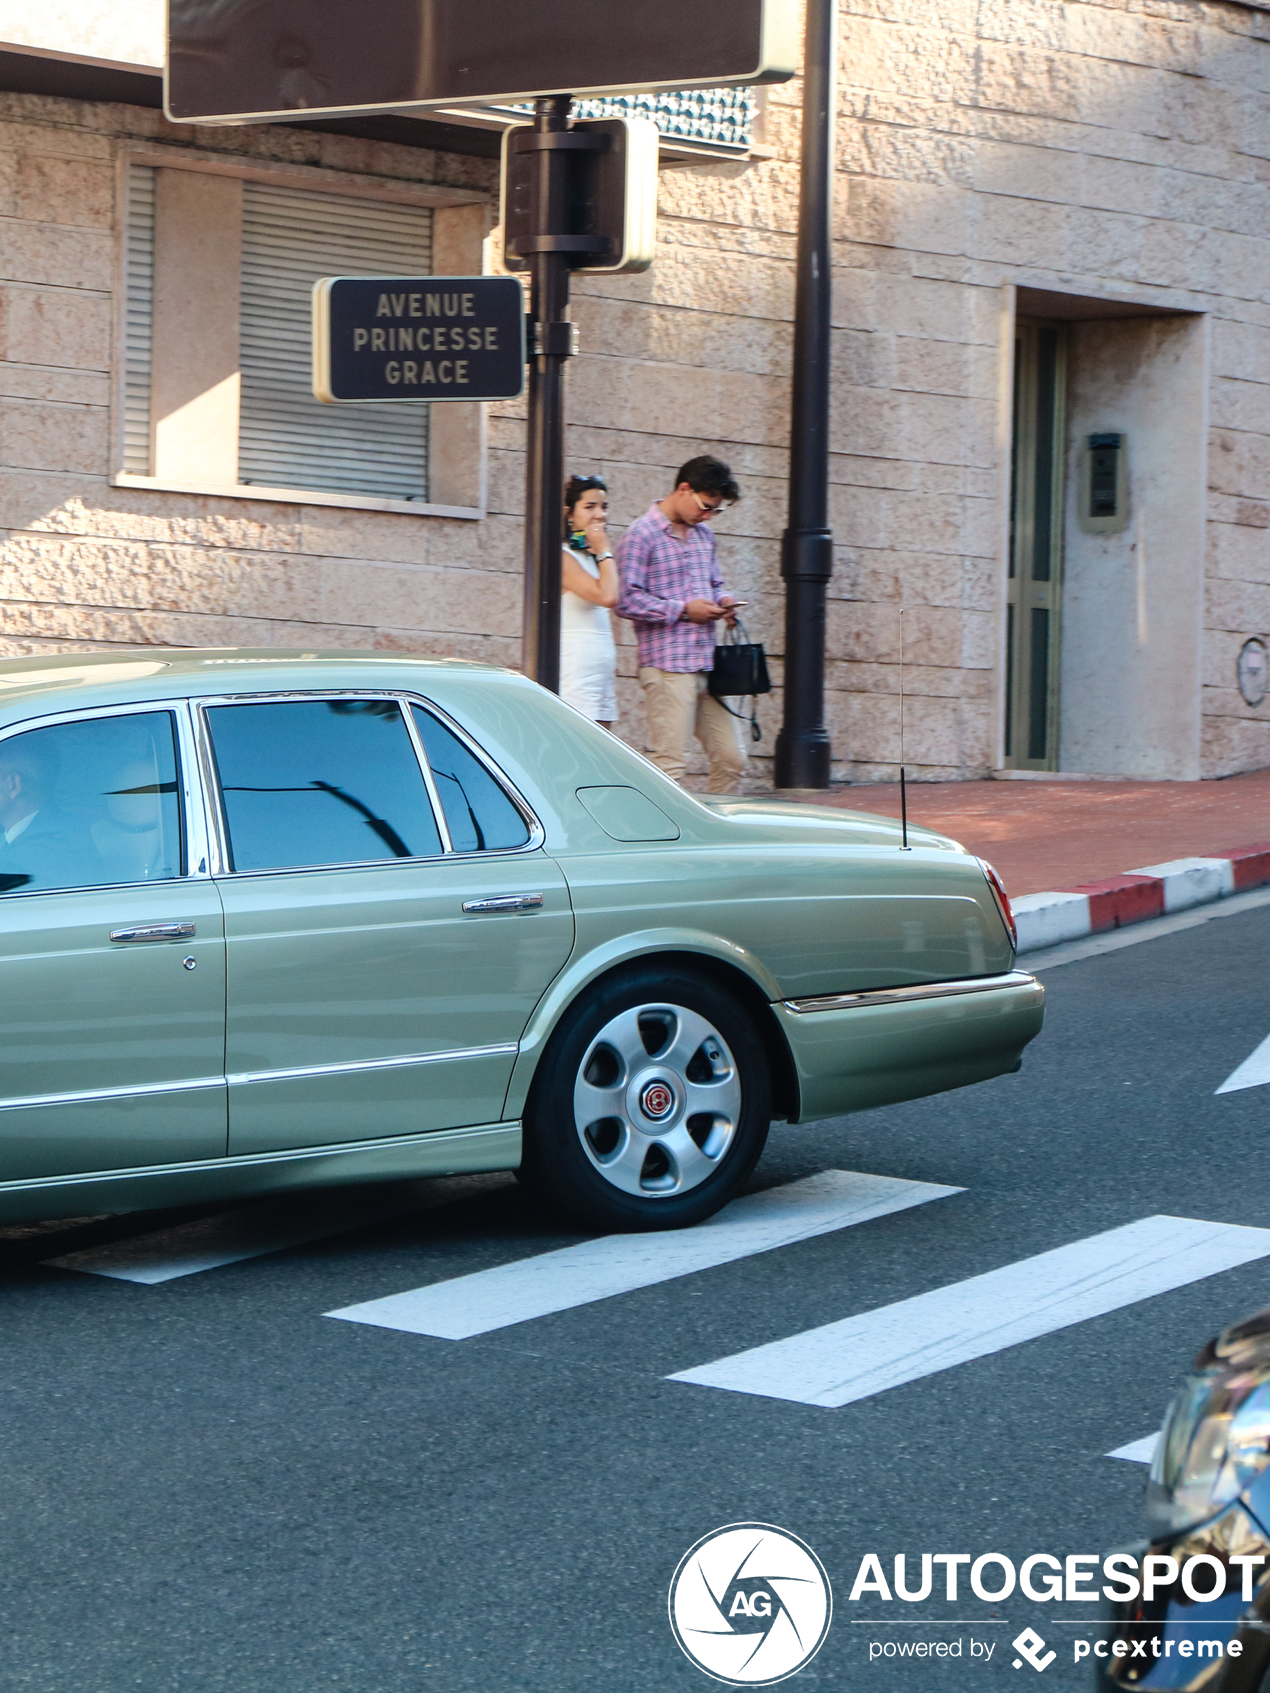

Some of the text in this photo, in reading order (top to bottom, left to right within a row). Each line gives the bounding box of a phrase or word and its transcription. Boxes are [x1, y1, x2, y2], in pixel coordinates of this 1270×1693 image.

[376, 293, 476, 317] AVENUE
[353, 327, 499, 351] PRINCESSE
[385, 360, 470, 384] GRACE
